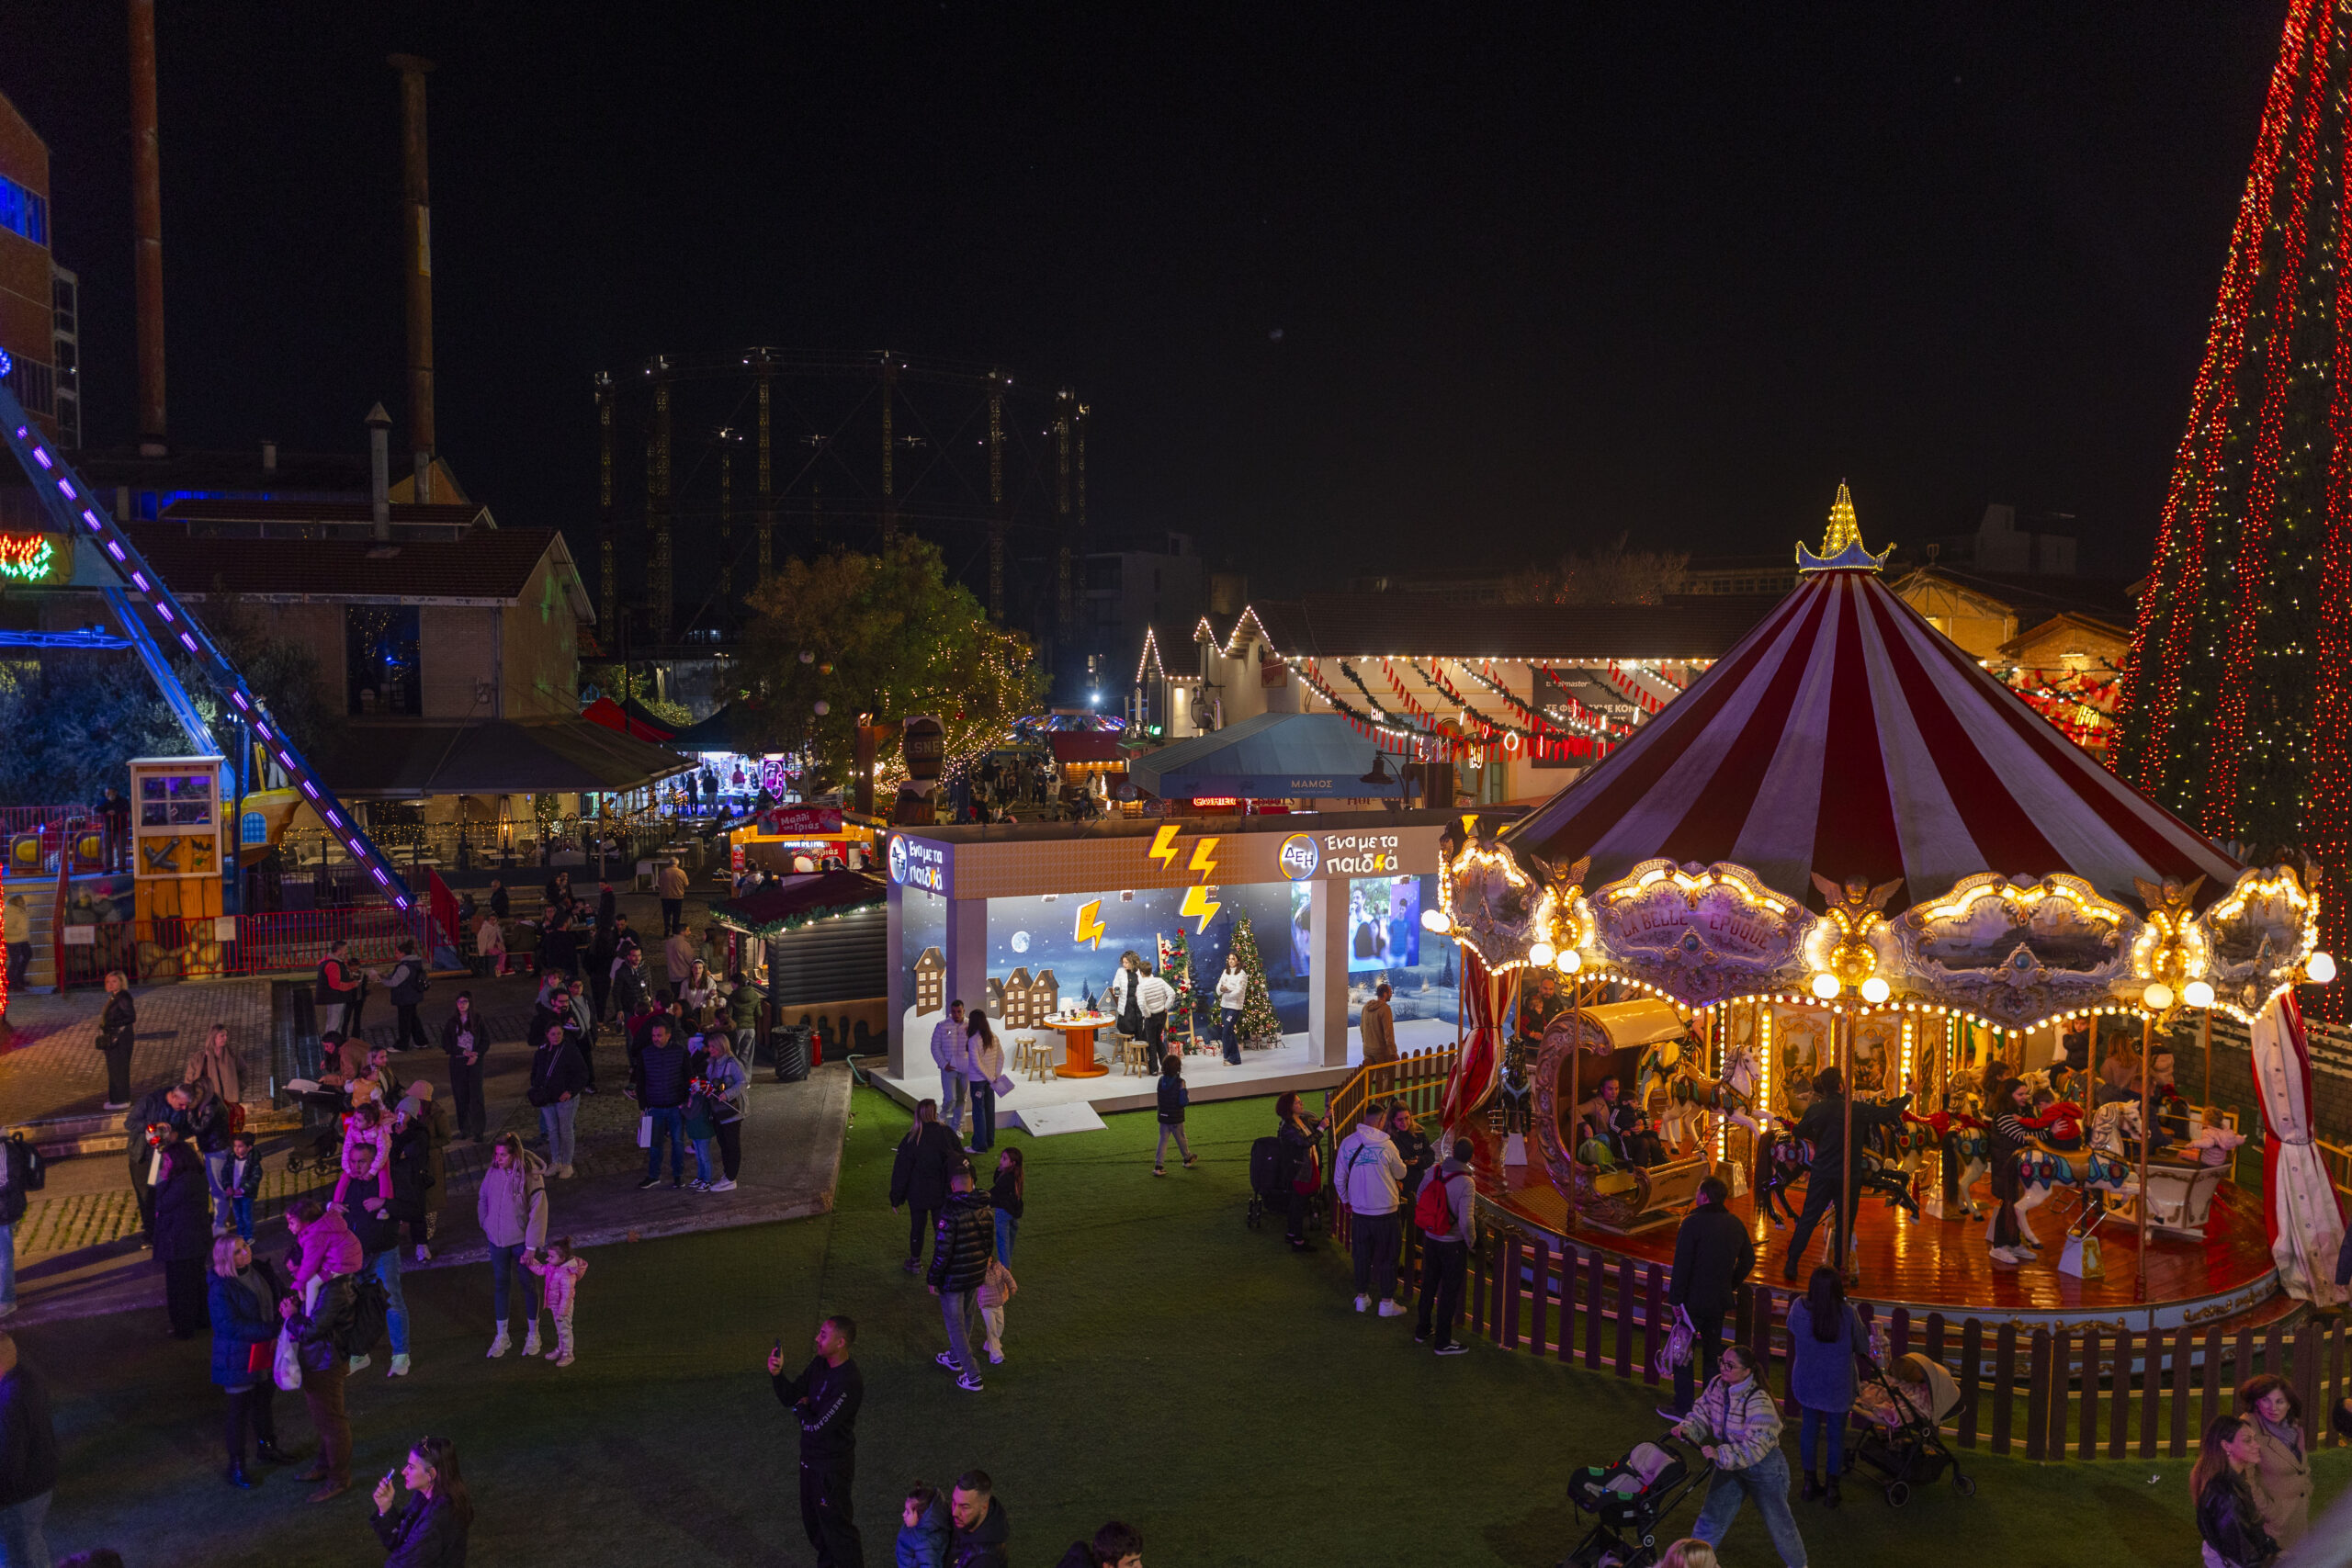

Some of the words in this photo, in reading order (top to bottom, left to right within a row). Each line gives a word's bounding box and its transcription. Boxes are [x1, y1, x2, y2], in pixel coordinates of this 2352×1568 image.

[1291, 779, 1333, 789] ΜΑΜΟΣ
[1358, 837, 1378, 852] με
[1379, 835, 1398, 848] τα
[818, 847, 839, 857] ριάς
[933, 849, 943, 863] τα
[1284, 847, 1314, 866] ΔΕΗ
[1622, 915, 1640, 938] LA
[1641, 908, 1689, 930] BELLE
[1709, 912, 1773, 951] EPOQUE
